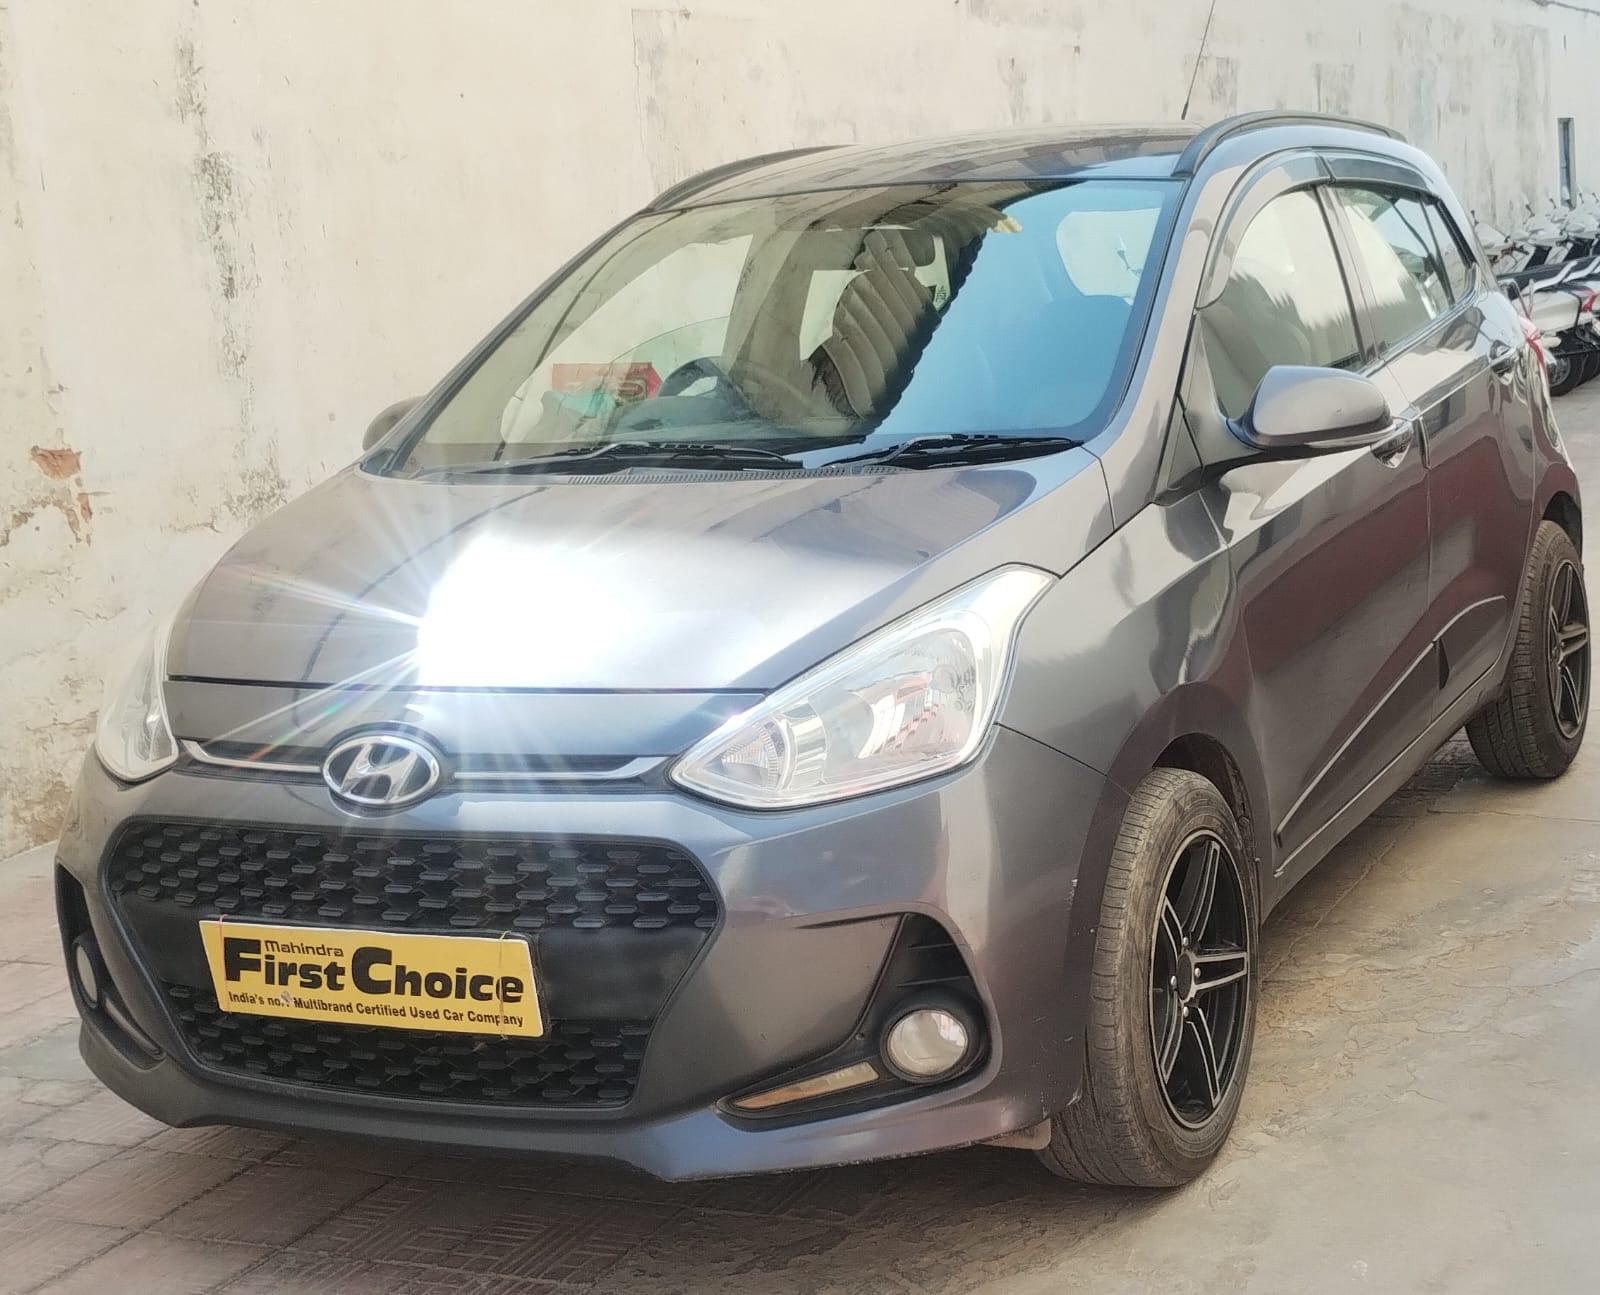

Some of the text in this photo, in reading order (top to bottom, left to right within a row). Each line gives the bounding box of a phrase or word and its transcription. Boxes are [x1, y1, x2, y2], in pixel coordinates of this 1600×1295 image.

[265, 940, 344, 957] Mahindra
[224, 937, 524, 1003] First Choice
[228, 991, 264, 1005] India's
[294, 997, 353, 1013] Multibrand
[356, 1003, 406, 1017] Certified
[410, 1006, 440, 1019] Used
[443, 1009, 464, 1021] Car
